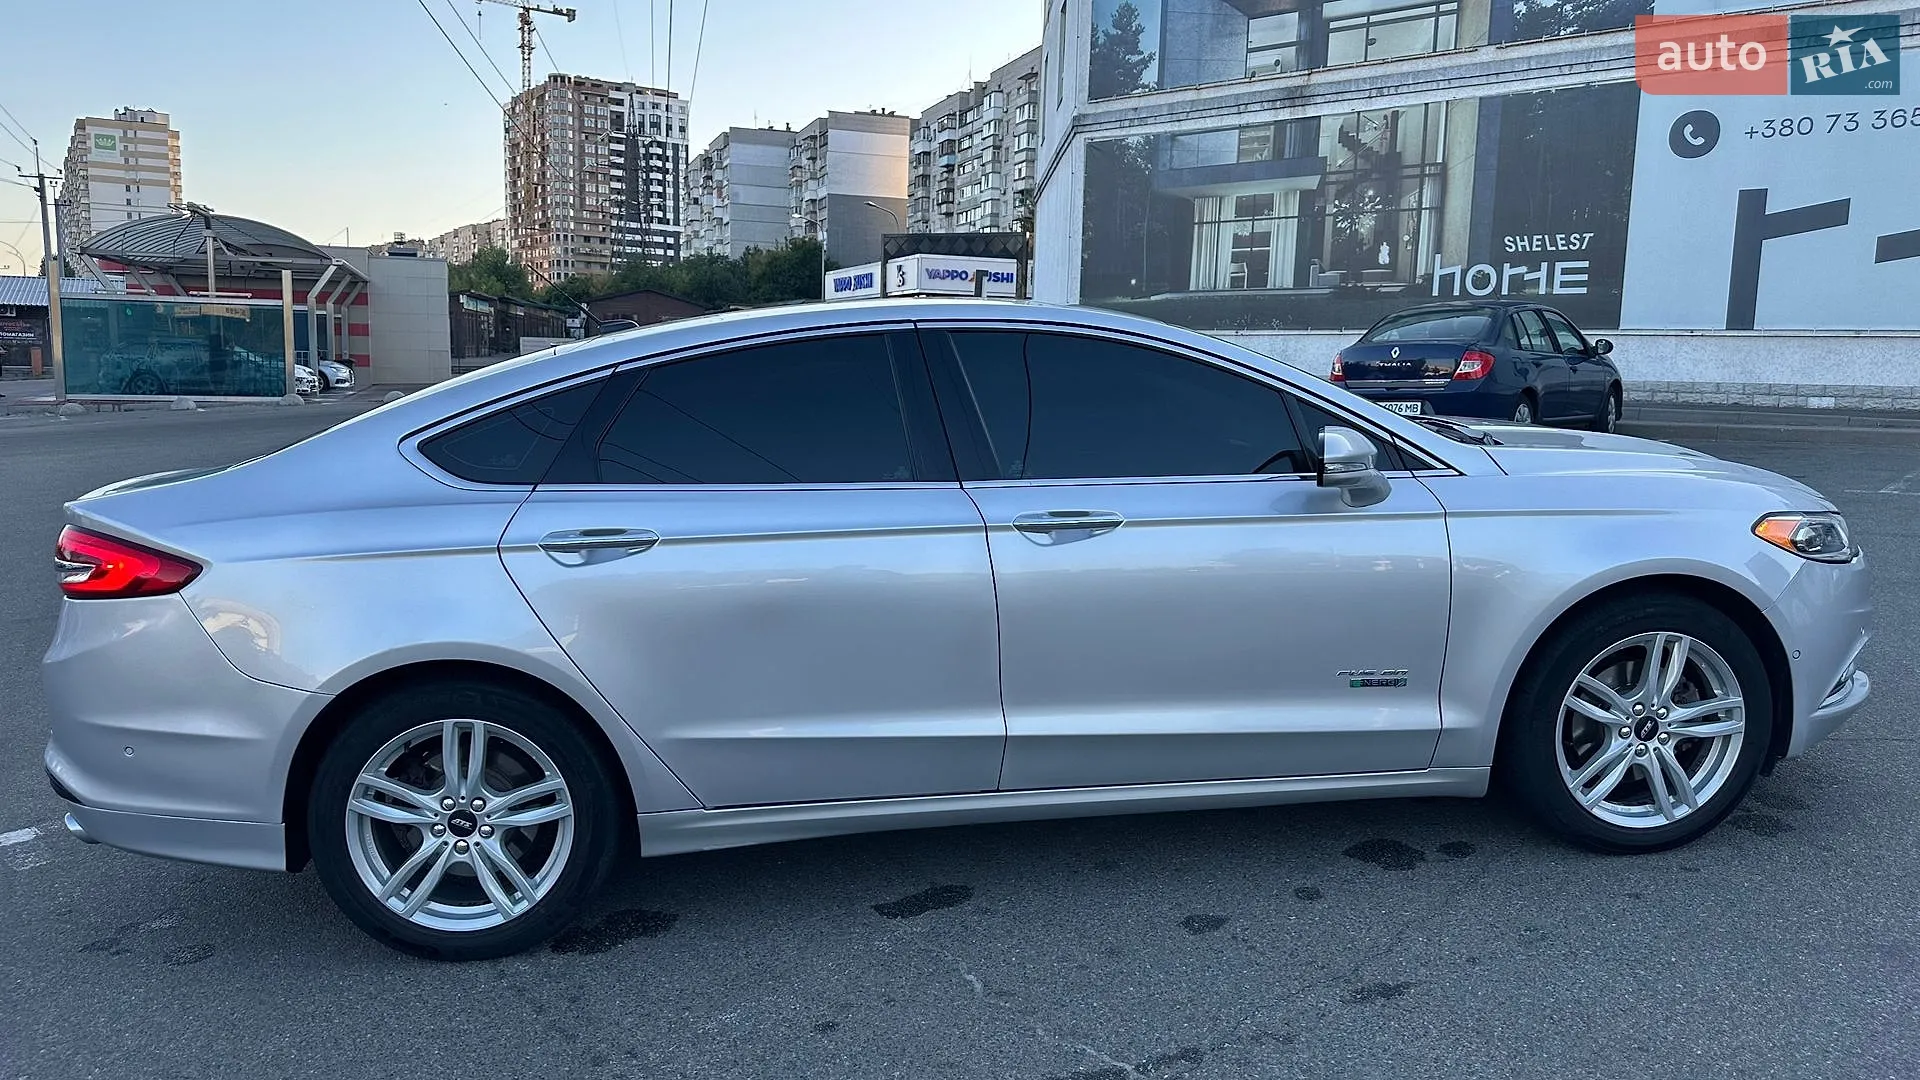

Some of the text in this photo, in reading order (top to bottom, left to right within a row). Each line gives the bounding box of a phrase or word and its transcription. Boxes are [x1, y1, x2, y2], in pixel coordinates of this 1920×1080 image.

[1744, 116, 1814, 139] +380
[1826, 112, 1860, 134] 73
[1504, 233, 1594, 252] SHELEST
[925, 267, 1014, 284] YAPPO USHI
[1335, 669, 1409, 677] FUSON
